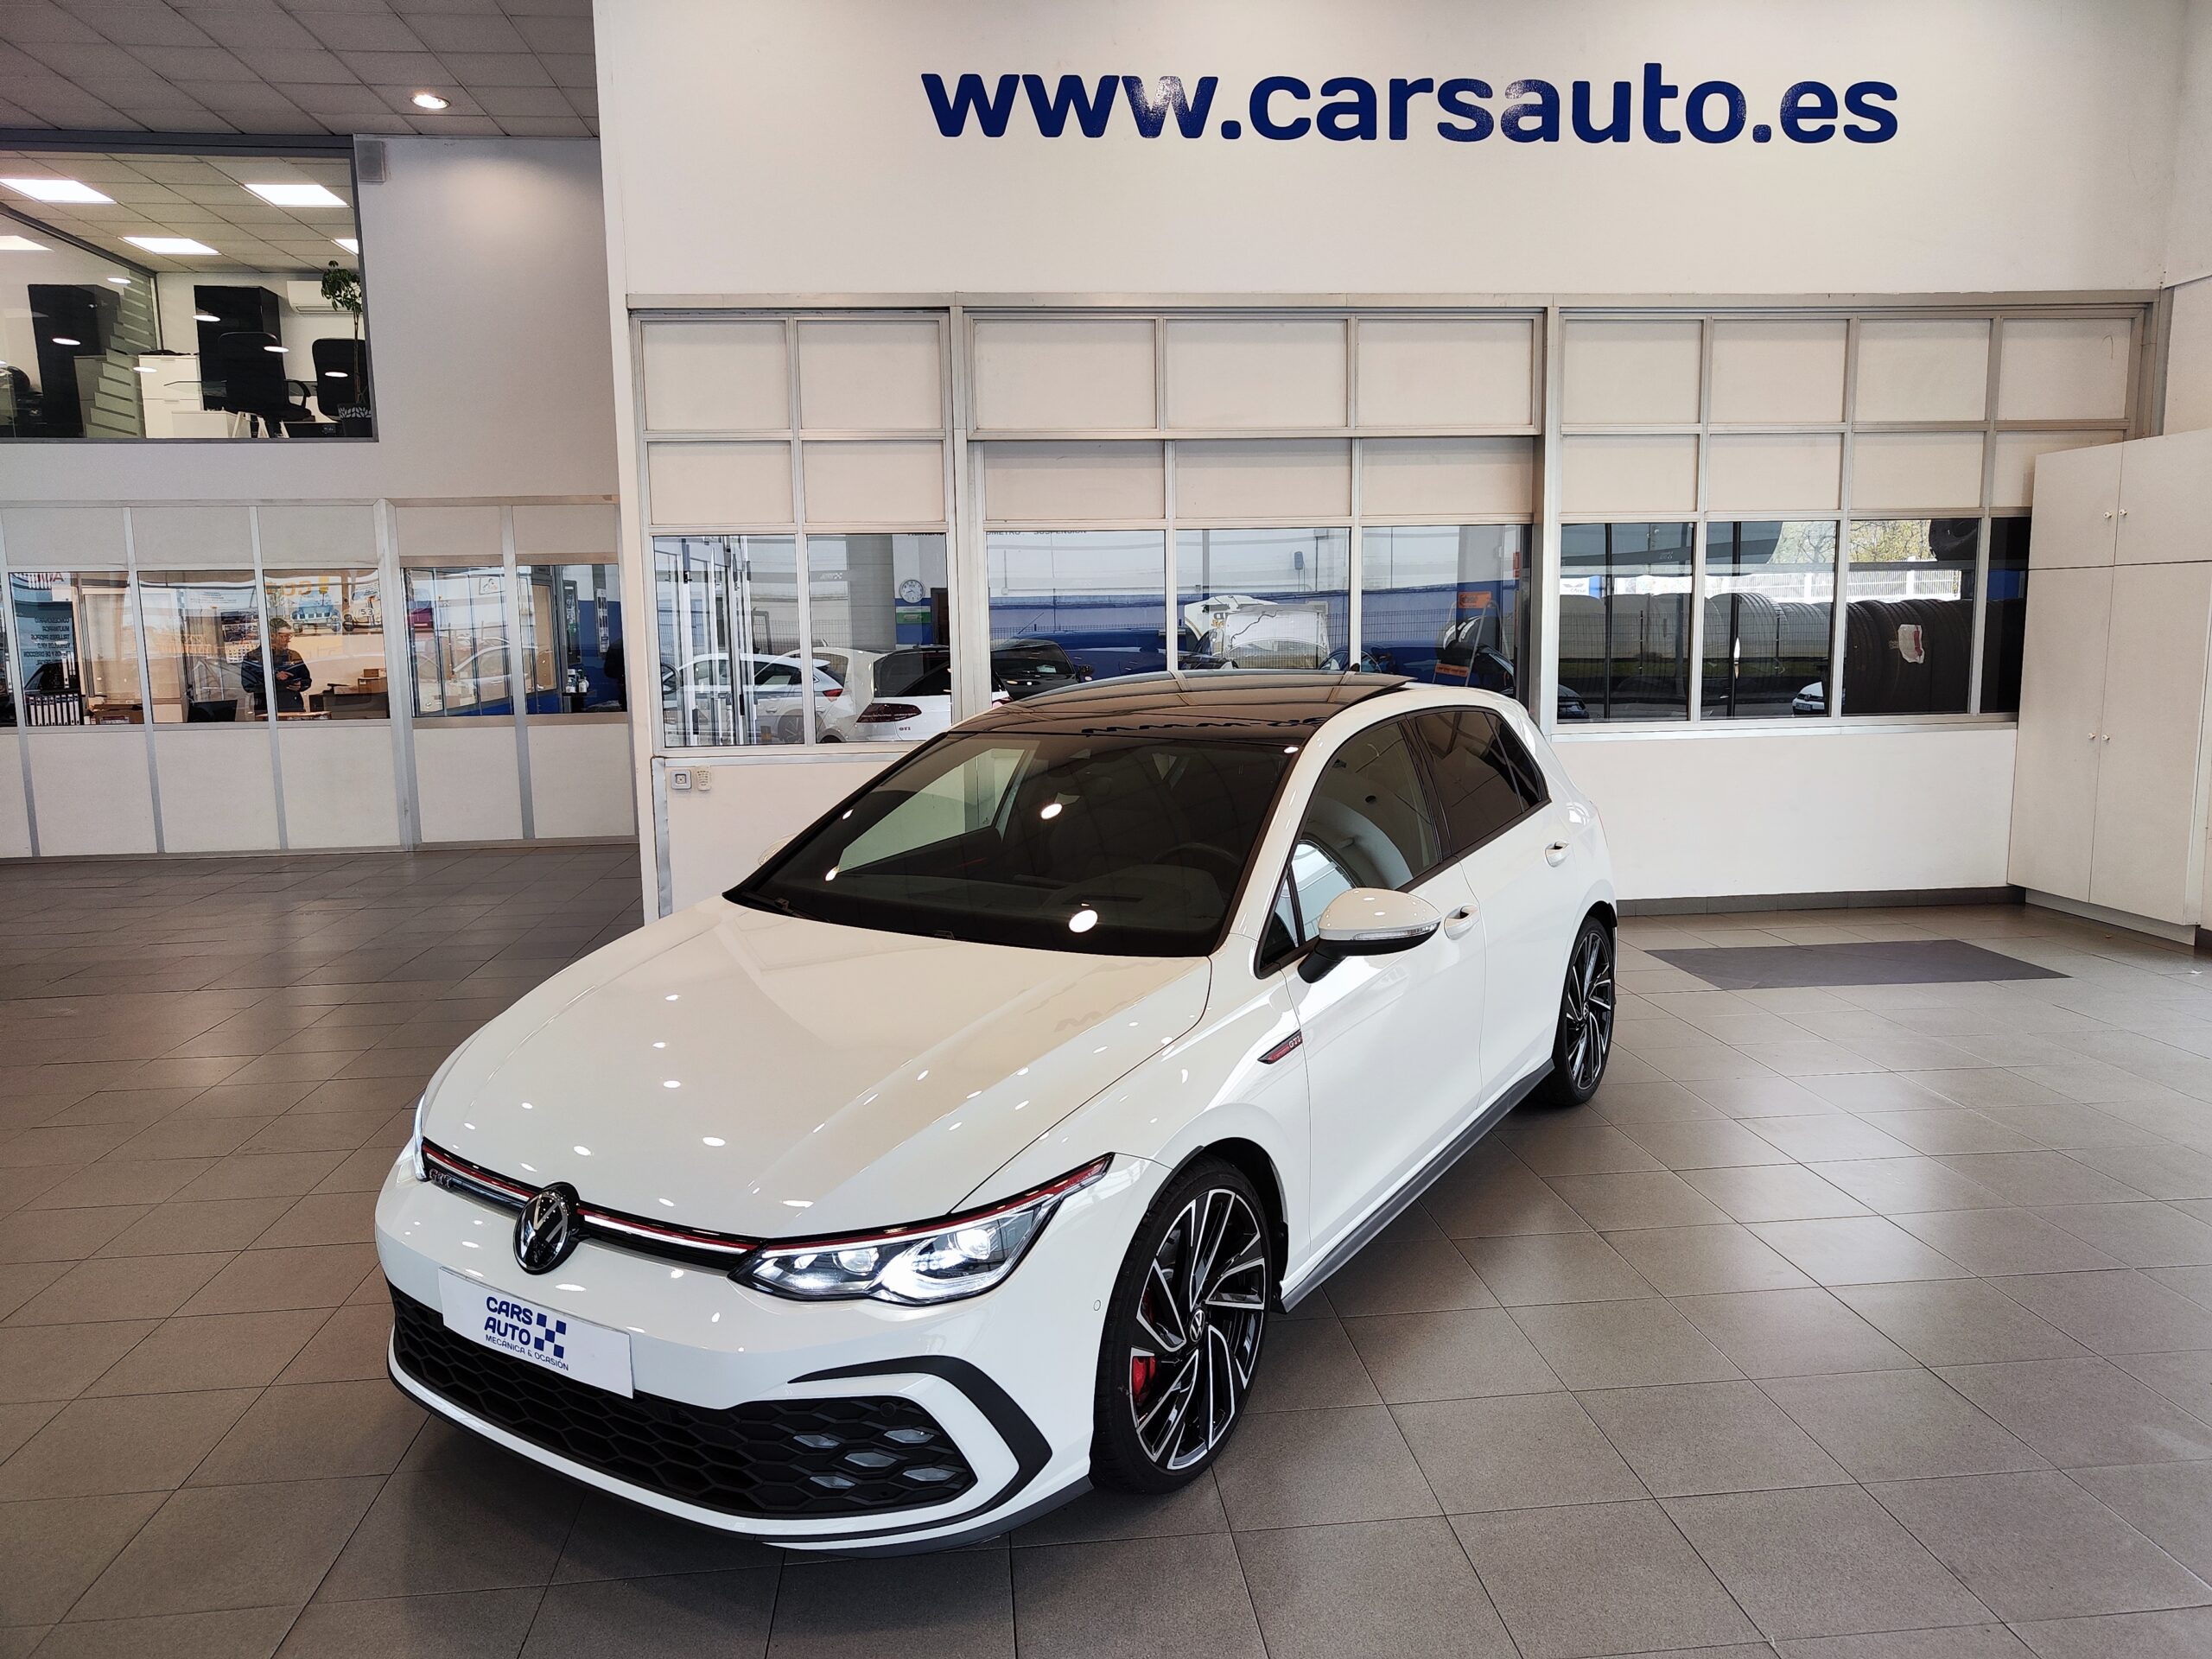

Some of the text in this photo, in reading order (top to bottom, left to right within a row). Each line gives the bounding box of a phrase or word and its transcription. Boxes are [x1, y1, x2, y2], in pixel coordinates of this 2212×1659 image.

[921, 63, 1897, 143] www.carsauto.es
[1288, 1035, 1300, 1048] GTI
[429, 1168, 452, 1188] GTI
[486, 1296, 533, 1325] CARS
[484, 1316, 531, 1345] AUTO
[486, 1334, 525, 1355] MECÁNICA
[534, 1351, 569, 1371] OCASIÓN
